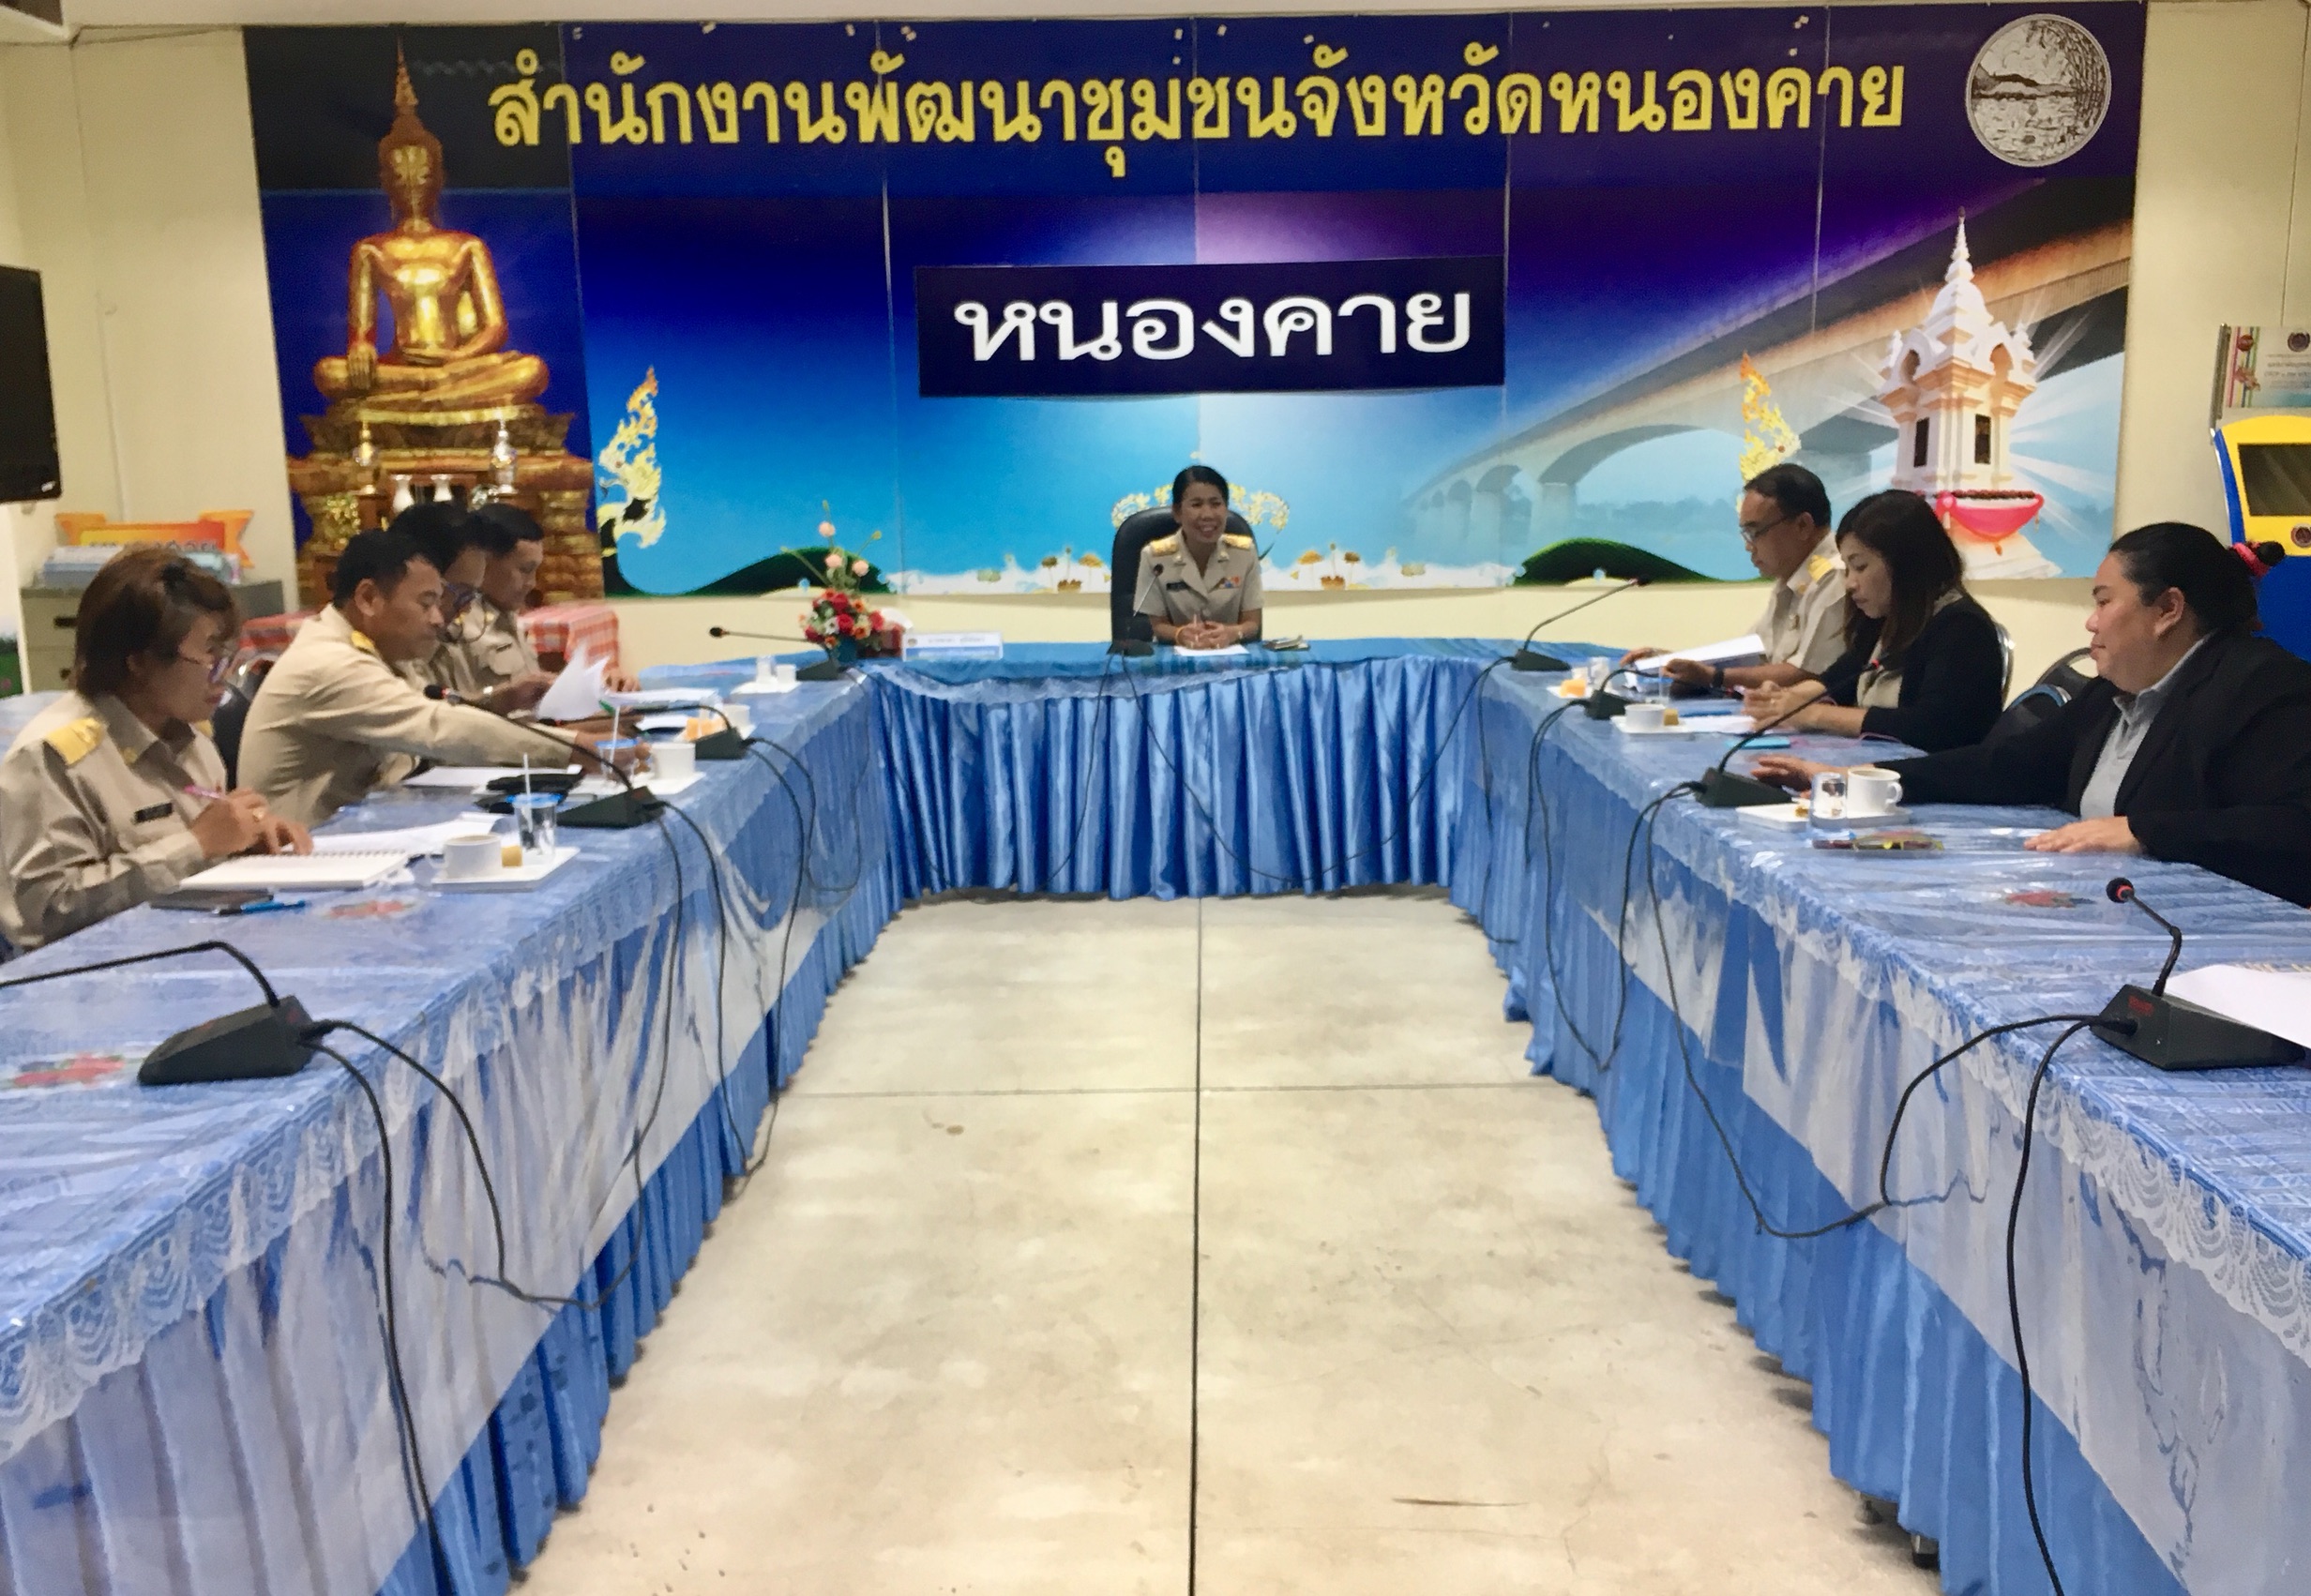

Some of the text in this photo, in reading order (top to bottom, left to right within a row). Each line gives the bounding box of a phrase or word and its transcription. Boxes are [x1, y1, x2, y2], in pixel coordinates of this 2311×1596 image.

[488, 42, 1905, 178] สำนักงานพัฒนาชุมชนจังหวัดหนองคาย
[954, 293, 1471, 362] หนองคาย
